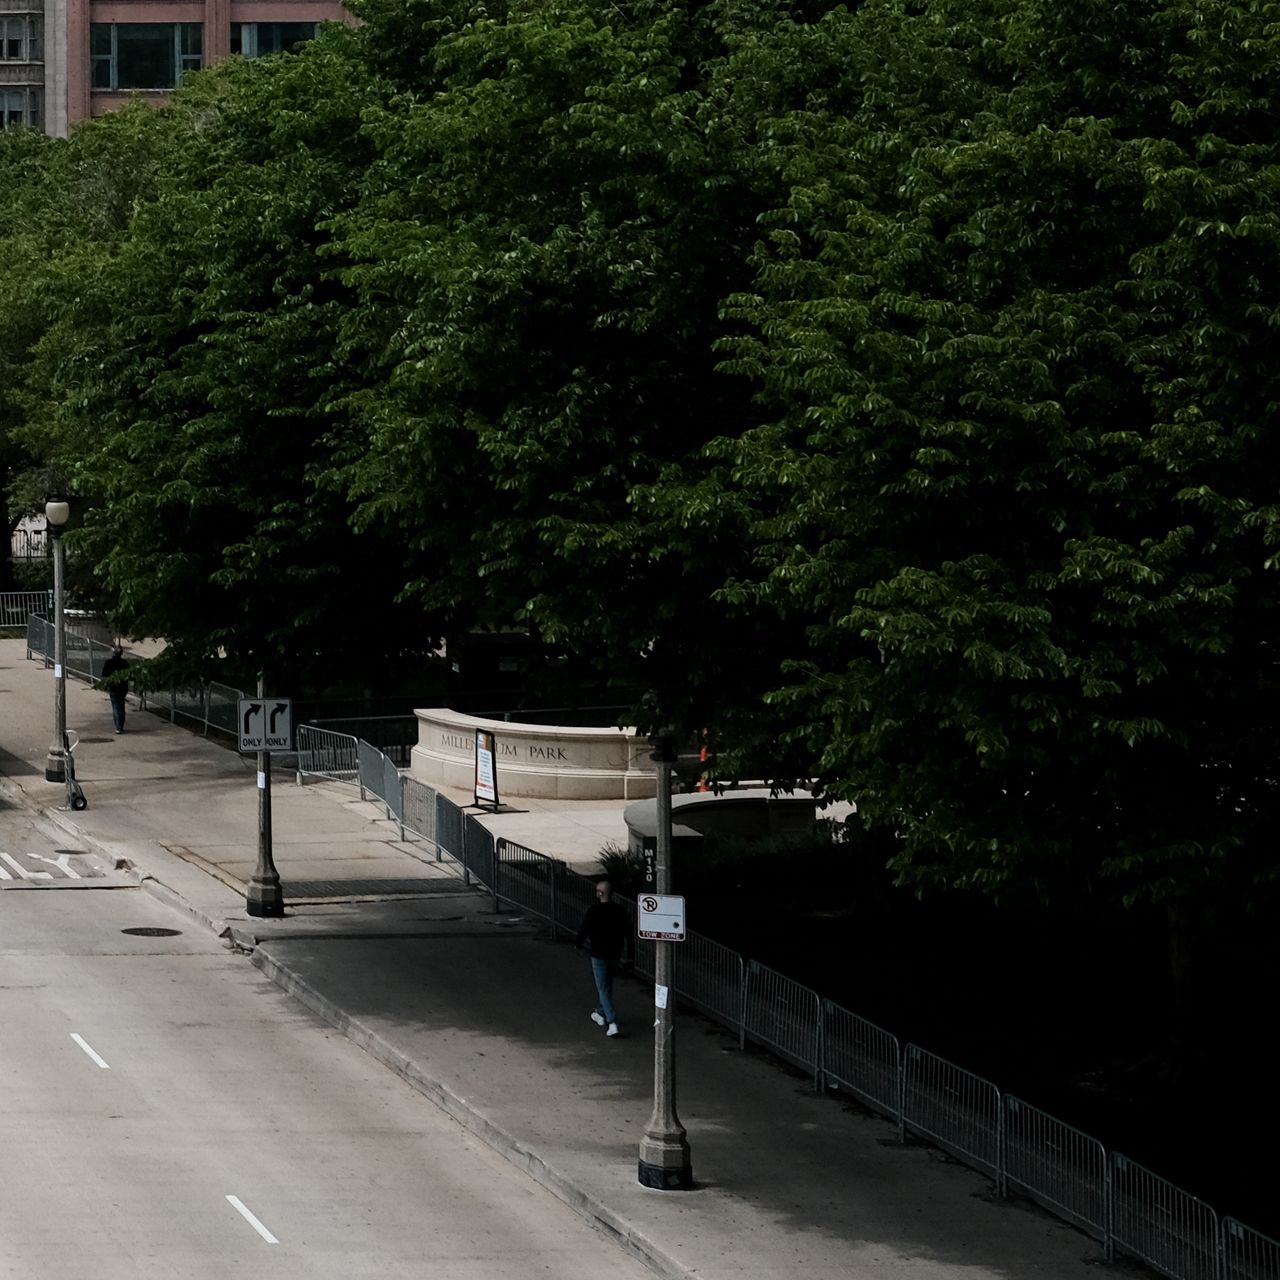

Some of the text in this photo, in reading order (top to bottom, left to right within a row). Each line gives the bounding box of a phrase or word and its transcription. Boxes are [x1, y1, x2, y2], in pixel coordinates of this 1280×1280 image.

[243, 738, 262, 747] ONLY
[268, 737, 287, 746] ONLY
[441, 734, 569, 761] MILLENUM PARK
[644, 848, 654, 882] M130
[661, 932, 681, 940] ZONE
